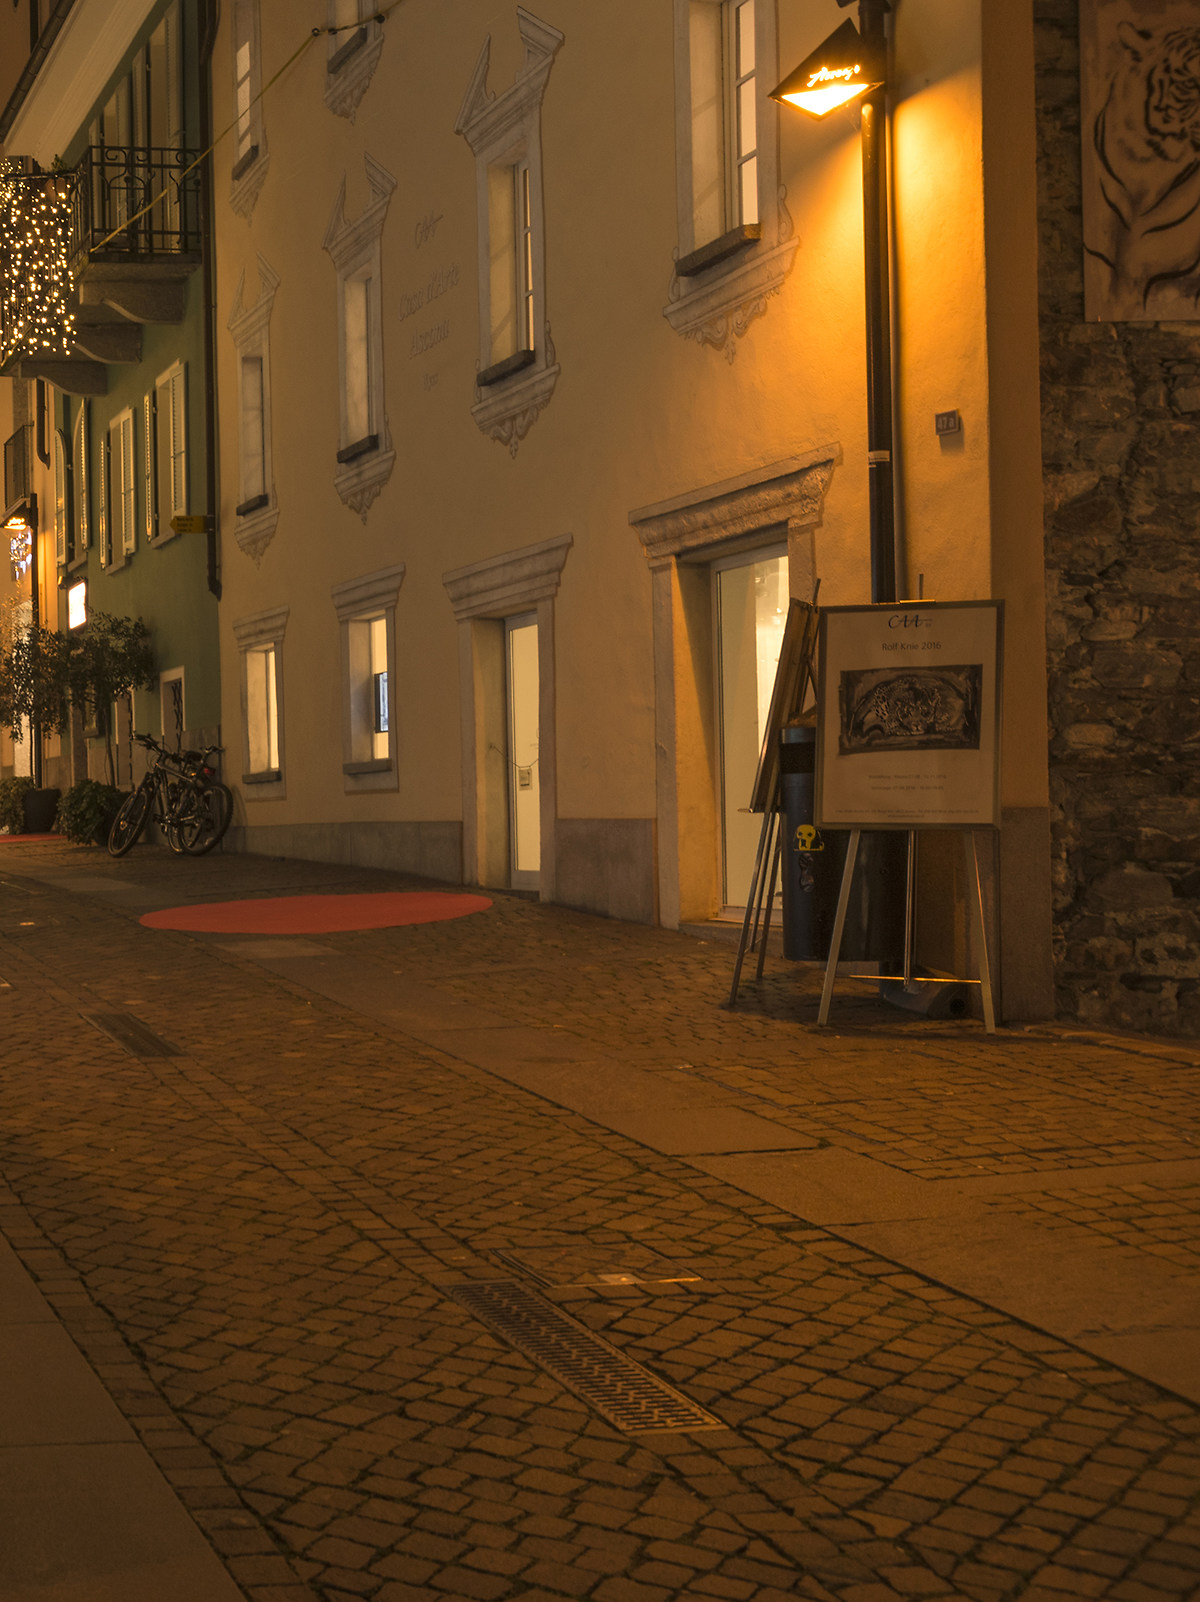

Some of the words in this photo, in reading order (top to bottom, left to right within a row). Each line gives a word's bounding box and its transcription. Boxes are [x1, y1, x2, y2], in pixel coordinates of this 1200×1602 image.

[882, 642, 898, 651] Rolf
[901, 642, 919, 650] Knie
[921, 641, 942, 650] 2016
